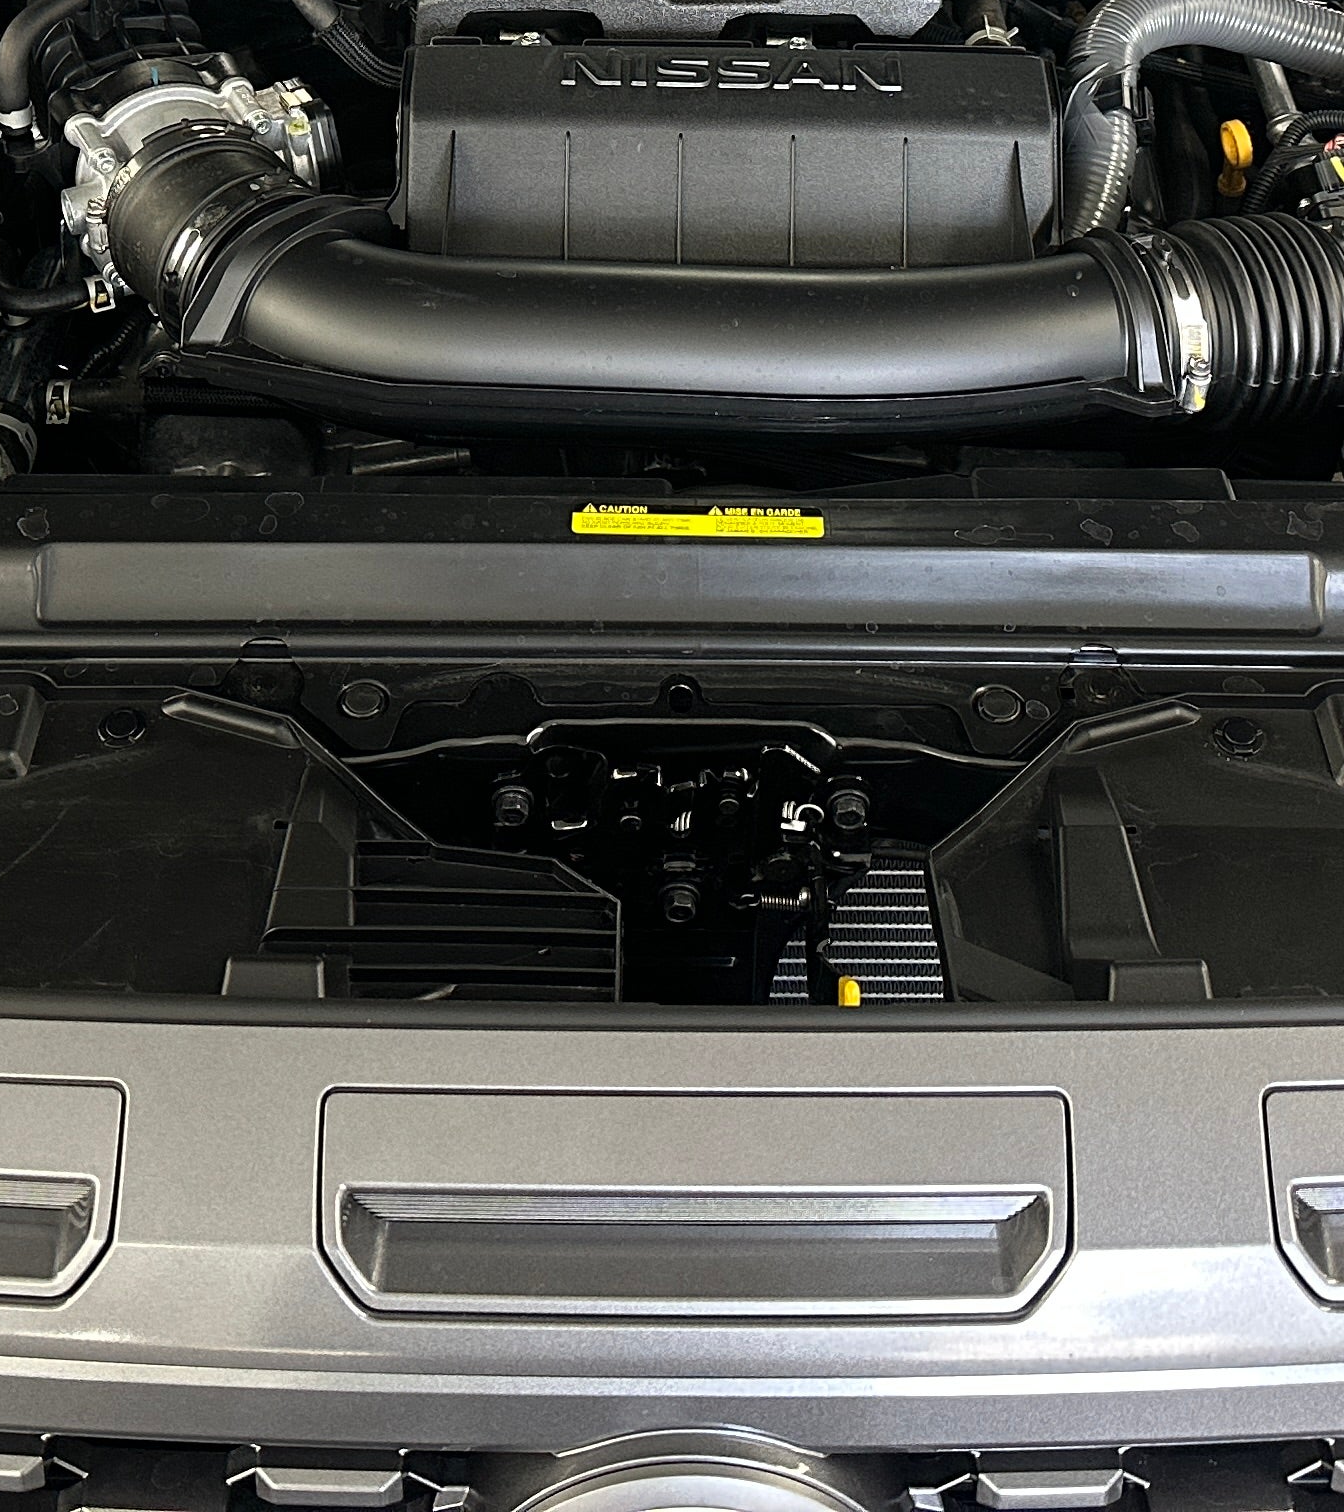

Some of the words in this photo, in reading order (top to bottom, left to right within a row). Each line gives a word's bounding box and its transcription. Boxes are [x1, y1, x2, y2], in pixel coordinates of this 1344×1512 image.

[560, 51, 903, 92] NISSAN
[599, 504, 648, 514] CAUTION
[724, 507, 749, 516] MISE
[750, 508, 765, 516] EN
